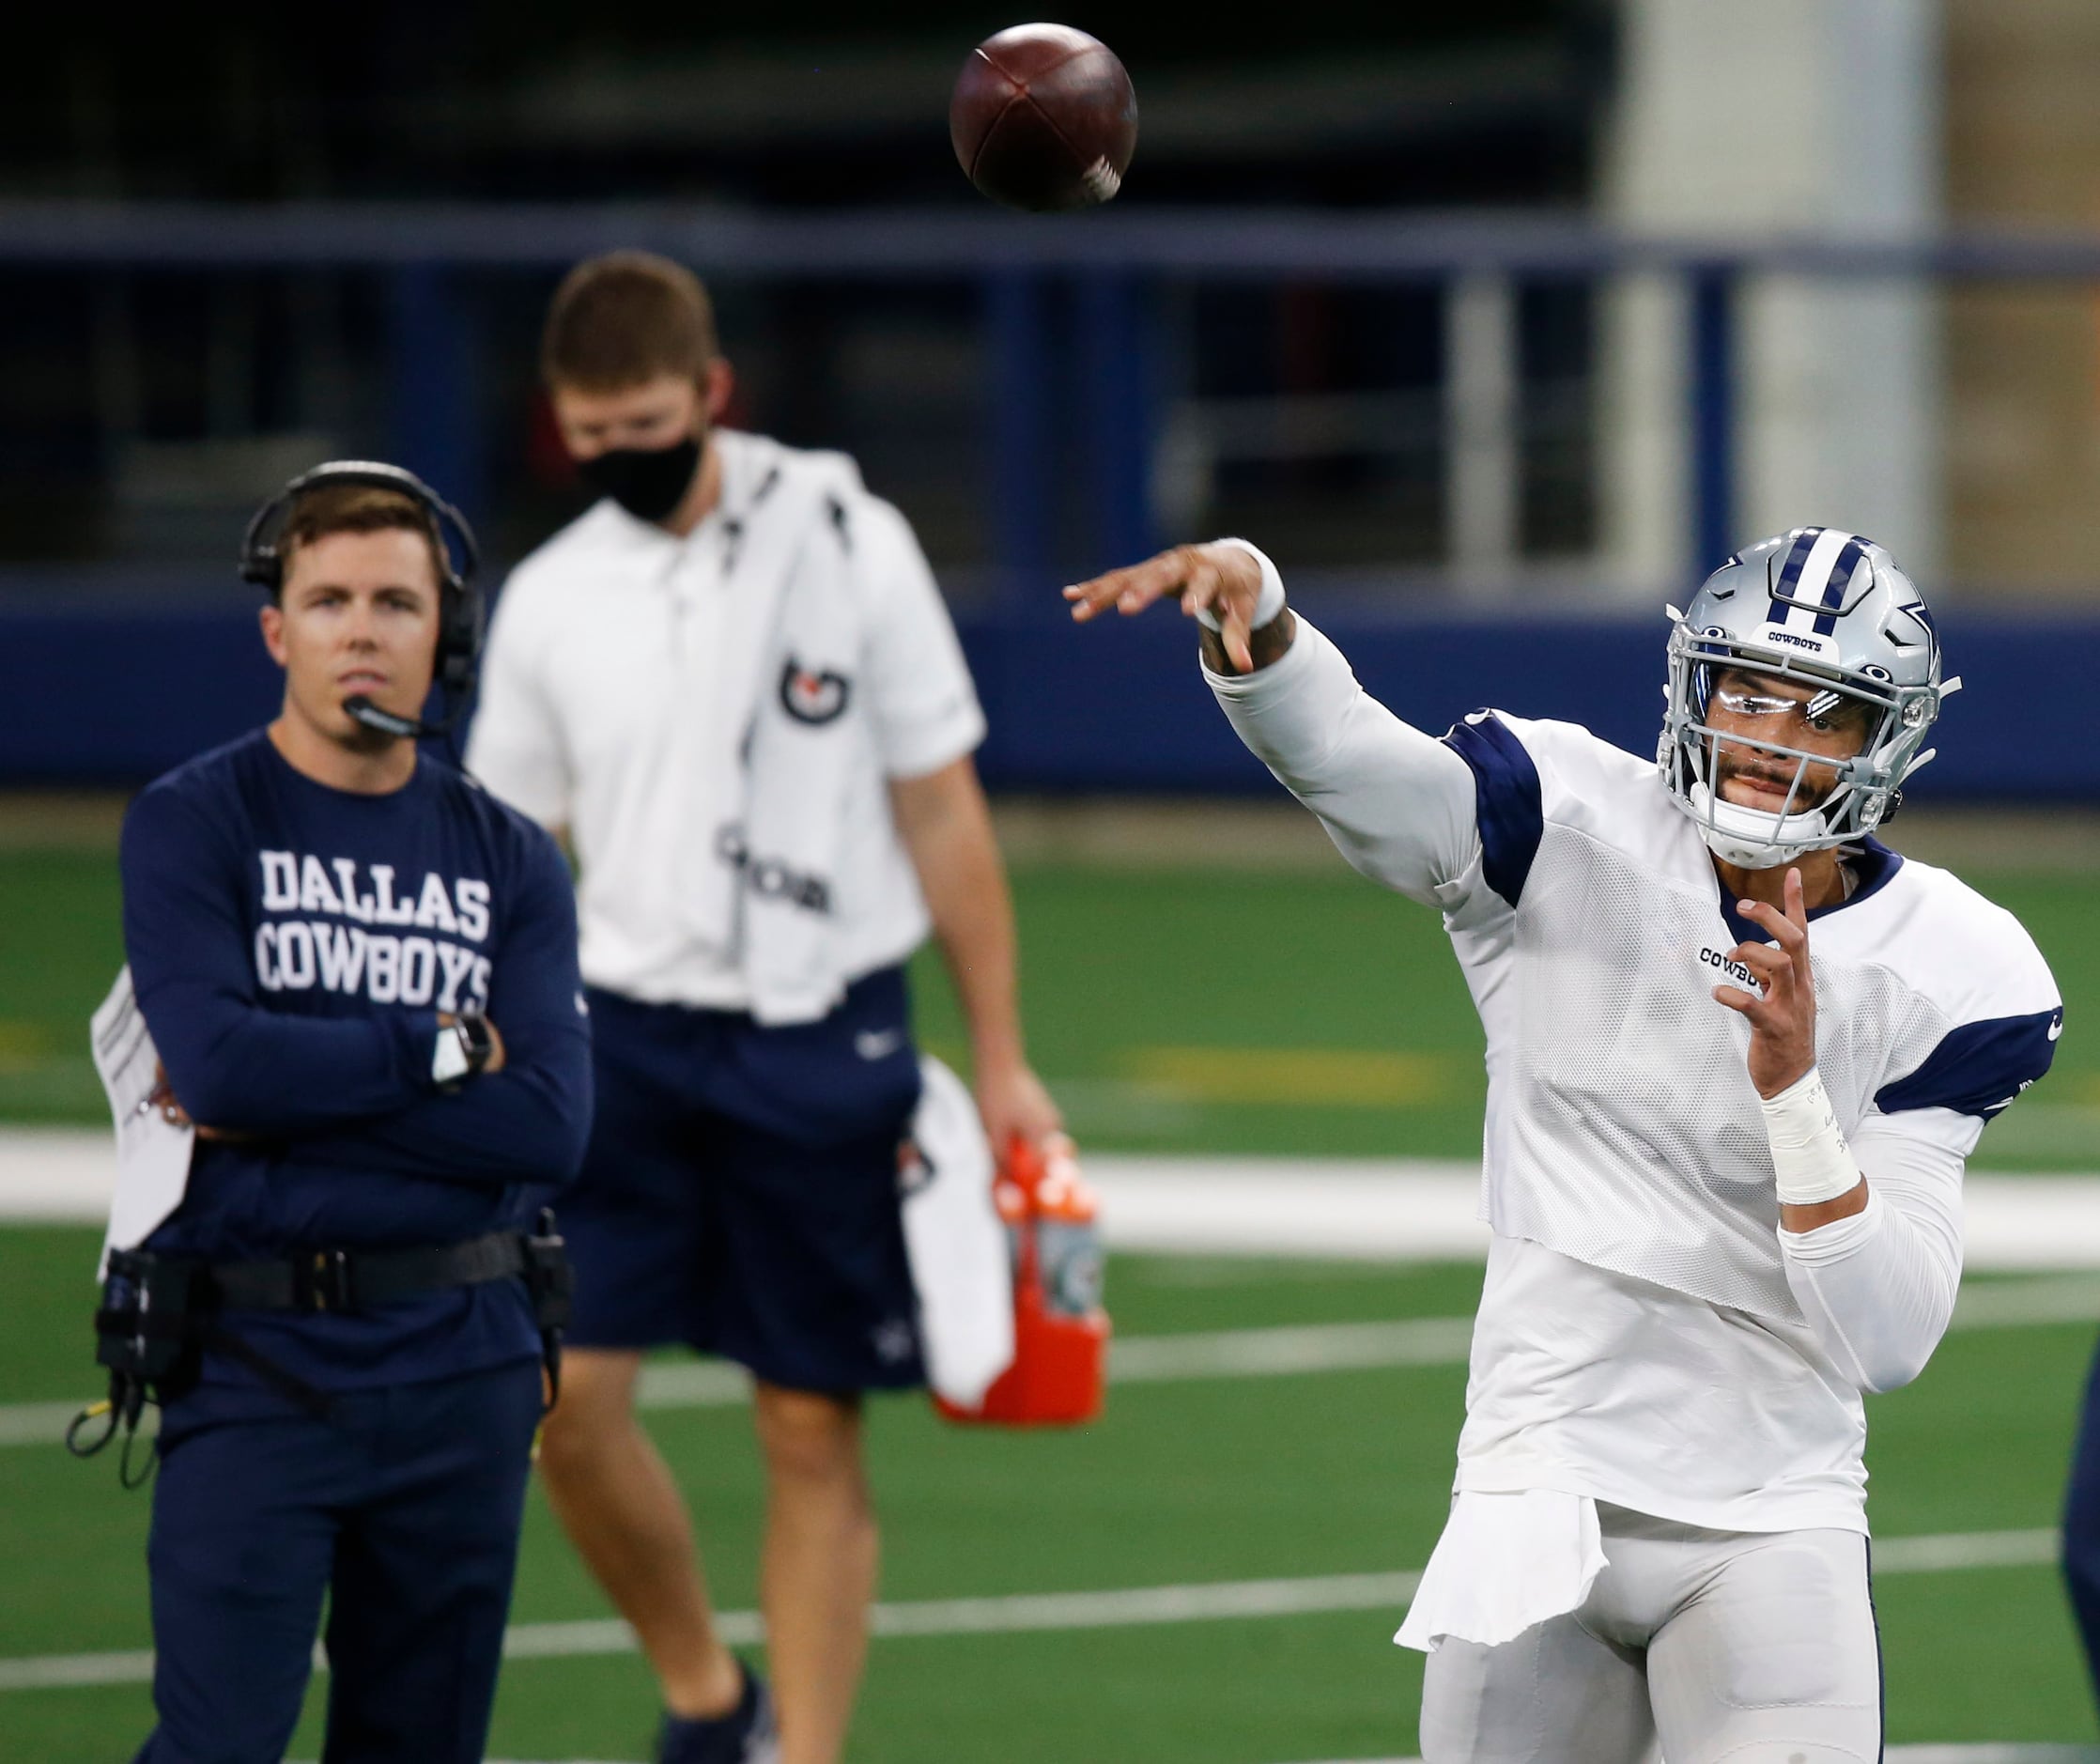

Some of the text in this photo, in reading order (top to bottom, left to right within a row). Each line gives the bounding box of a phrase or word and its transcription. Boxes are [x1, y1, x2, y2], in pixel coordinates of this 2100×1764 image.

[1768, 631, 1823, 653] COWBOYS
[258, 849, 491, 943] DALLAS
[255, 921, 492, 1015] COWBOYS
[1699, 947, 1758, 987] COWBO
